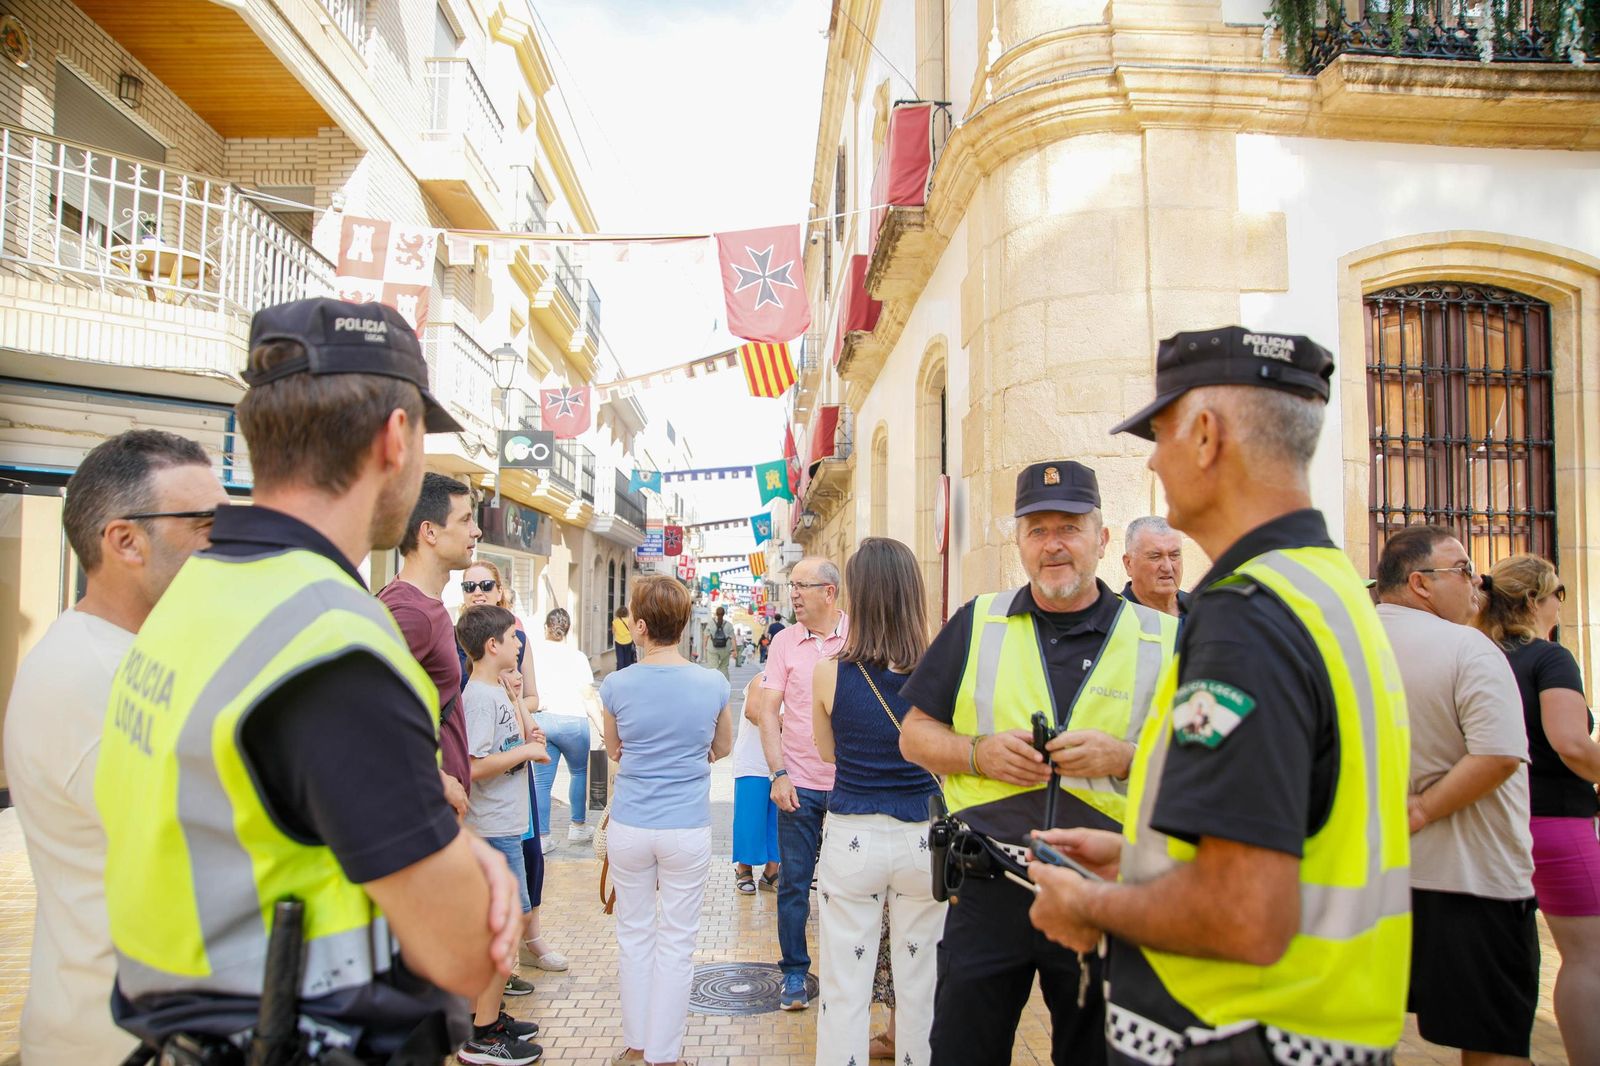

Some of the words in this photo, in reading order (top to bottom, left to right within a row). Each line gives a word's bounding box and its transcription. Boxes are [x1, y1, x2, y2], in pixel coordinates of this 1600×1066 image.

[335, 317, 388, 333] POLICIA
[1253, 345, 1294, 363] LOCAL
[1090, 686, 1129, 701] POLICIA
